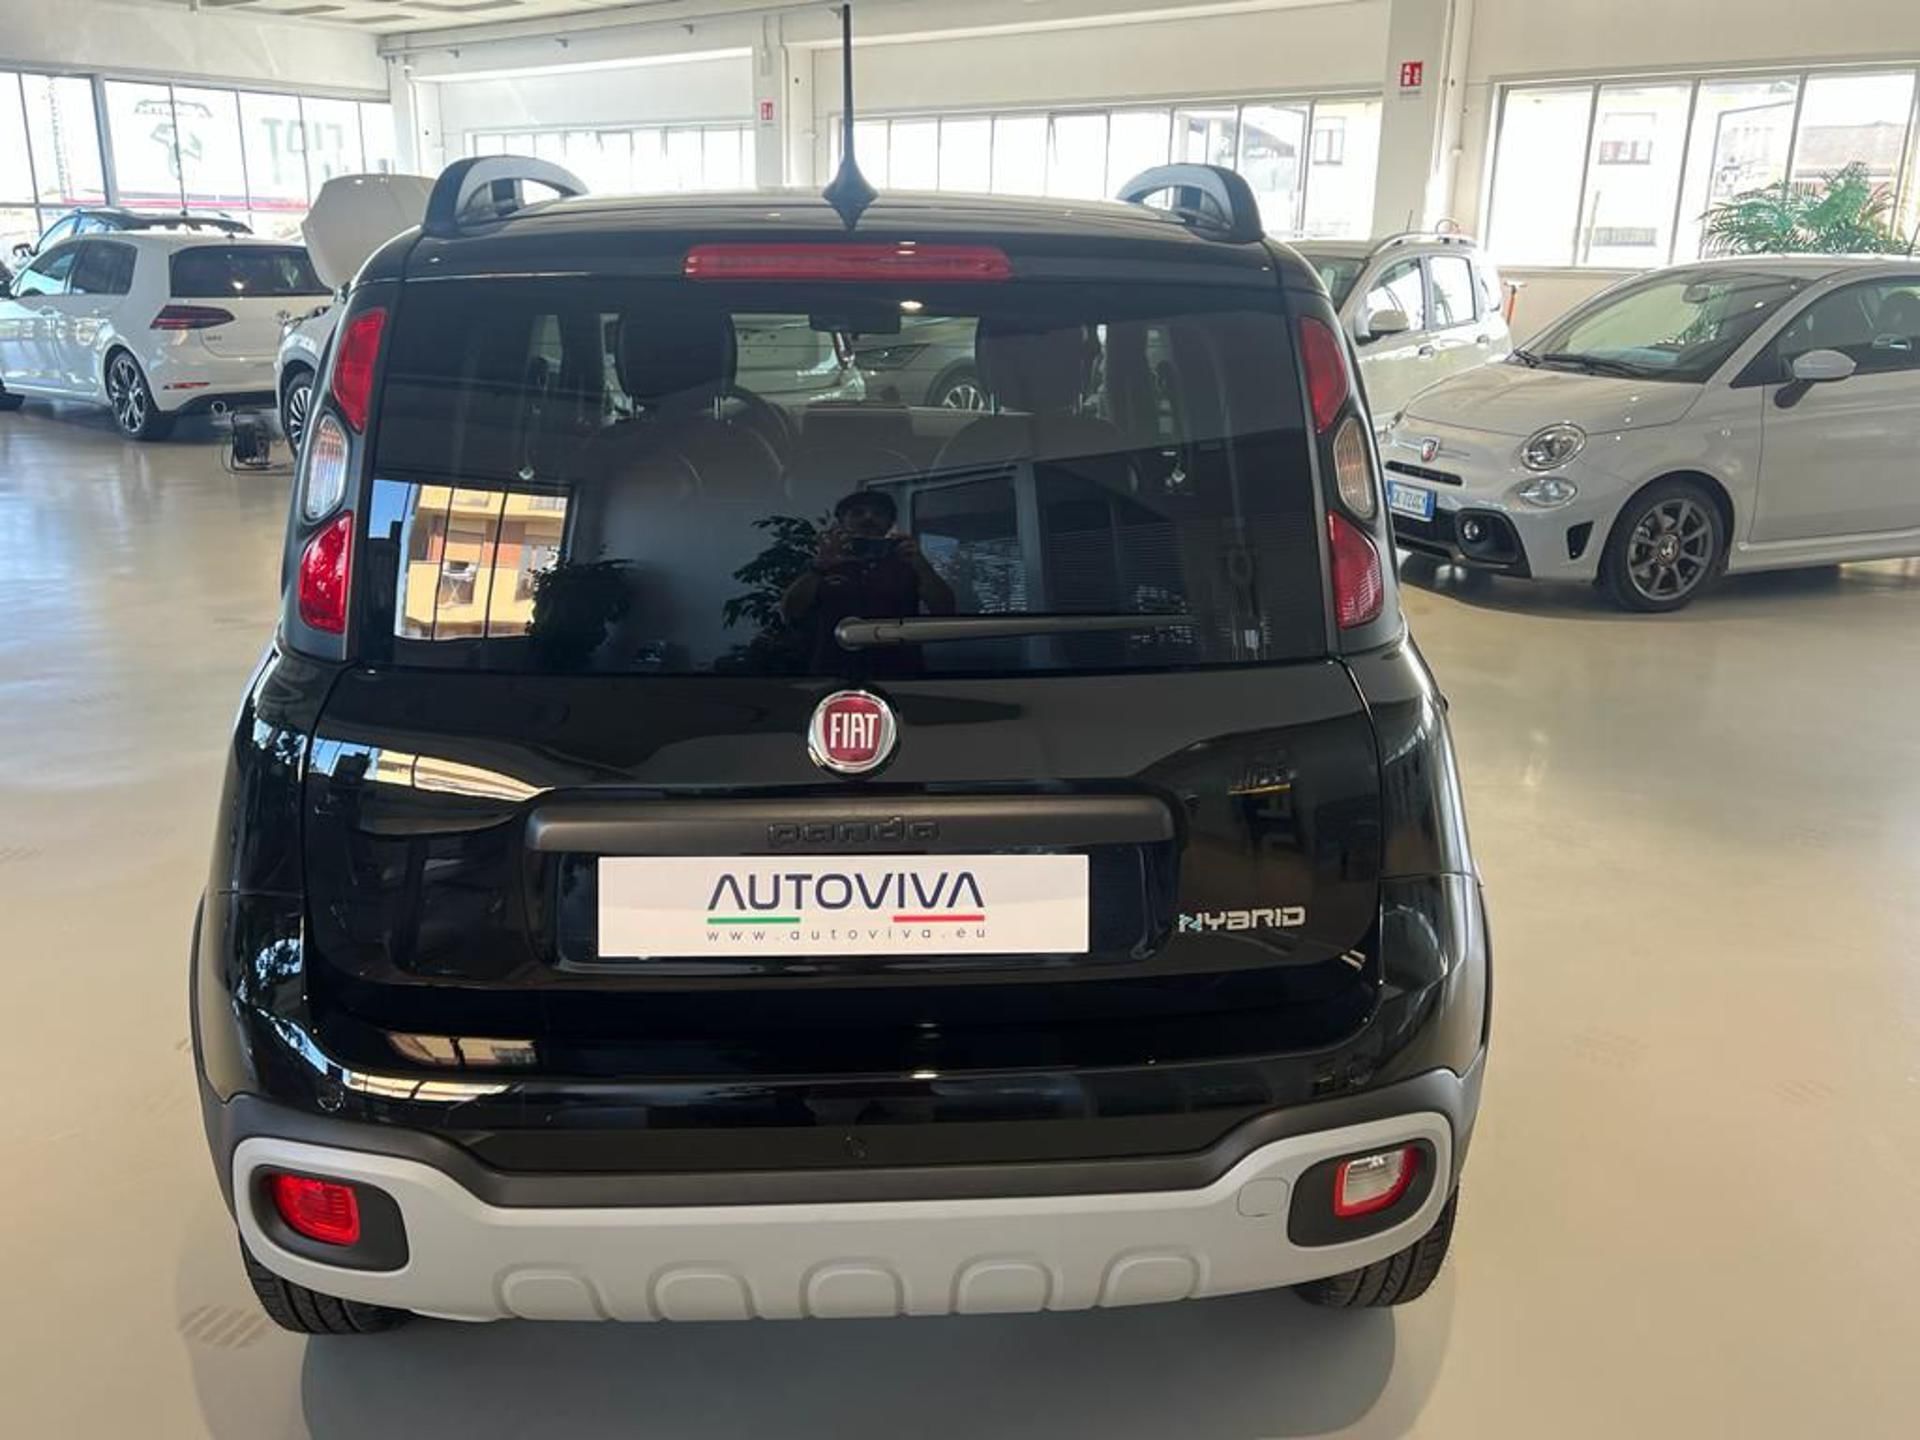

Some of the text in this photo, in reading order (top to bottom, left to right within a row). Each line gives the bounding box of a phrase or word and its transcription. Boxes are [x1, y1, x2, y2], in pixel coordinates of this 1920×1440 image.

[829, 712, 879, 749] FIAT
[767, 817, 941, 847] panda
[707, 871, 985, 911] AUTOVIVA
[706, 926, 986, 942] www.autoviva.eu
[1178, 905, 1306, 933] HYBRID
